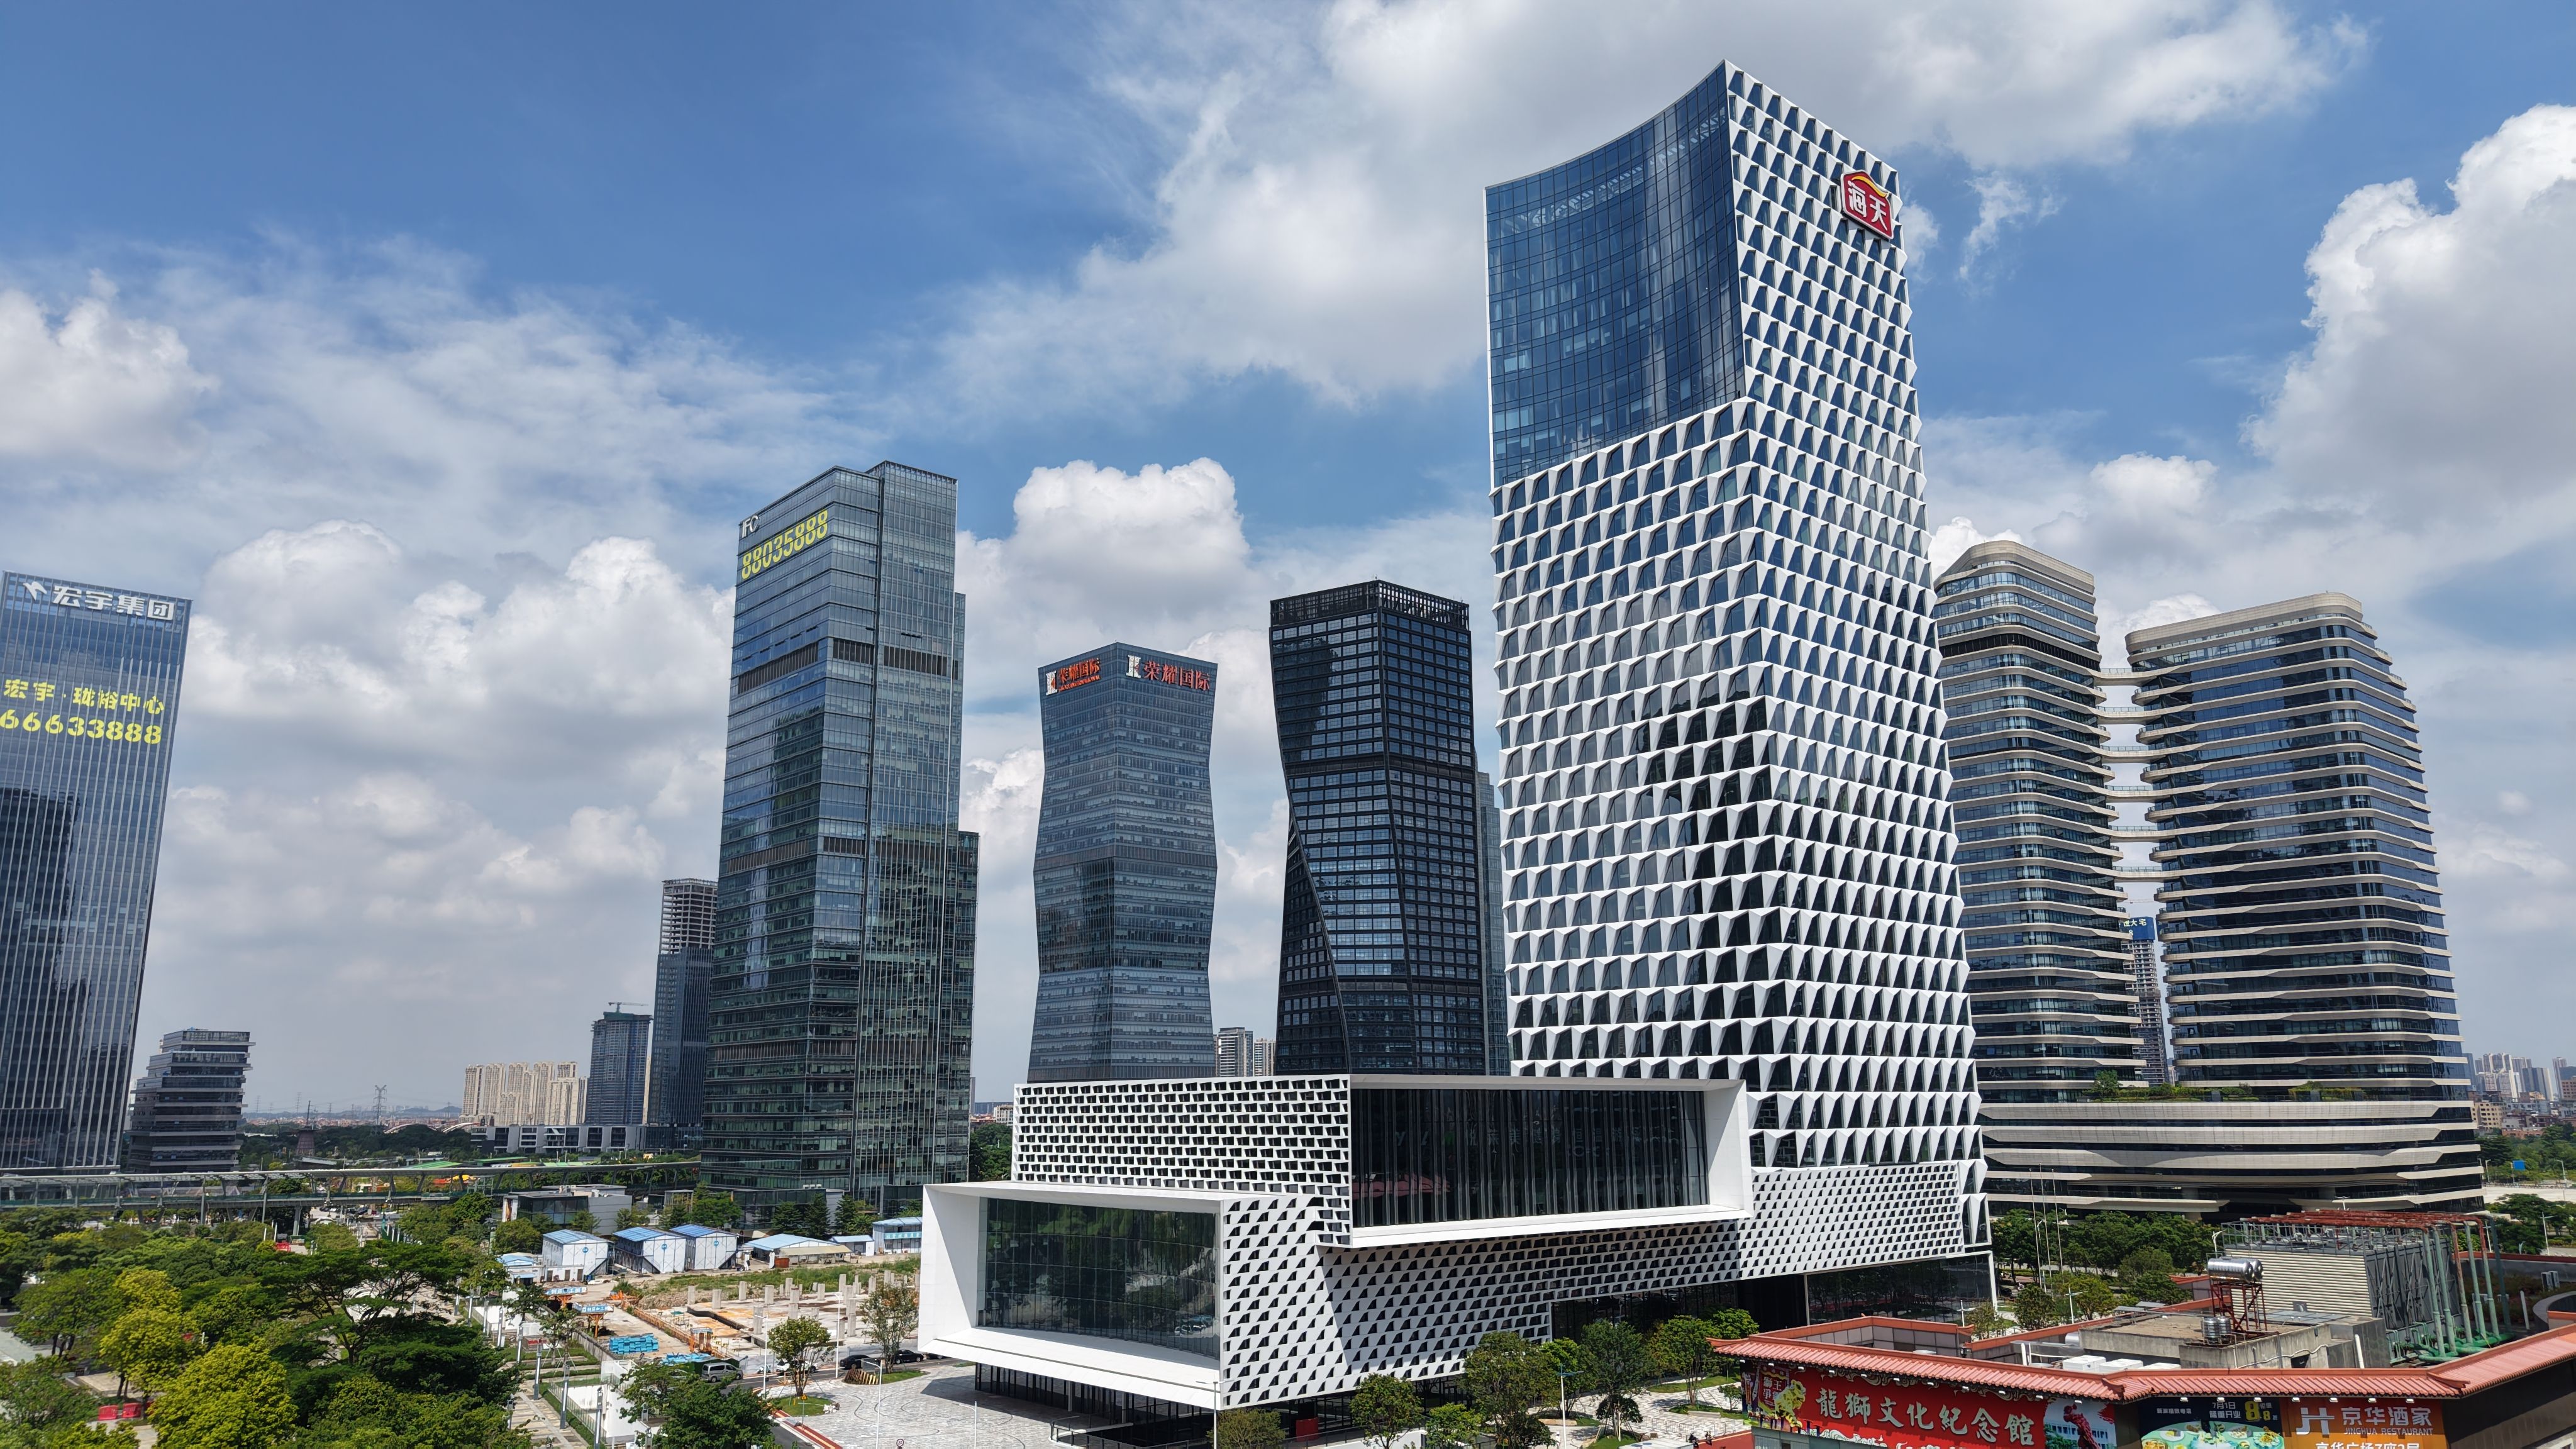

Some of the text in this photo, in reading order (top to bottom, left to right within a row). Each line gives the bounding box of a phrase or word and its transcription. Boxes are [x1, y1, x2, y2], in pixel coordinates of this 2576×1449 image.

[1847, 180, 1888, 231] 海天
[741, 514, 760, 538] IFC
[741, 508, 828, 580] 88035888
[52, 585, 175, 621] 宏宇集团
[1143, 660, 1211, 691] 荣耀国际
[0, 709, 162, 745] 66633888
[1816, 1387, 2035, 1446] 龍獅文化紀念館
[2341, 1406, 2433, 1426] 京华酒家
[2381, 1428, 2433, 1436] RESTAURANT
